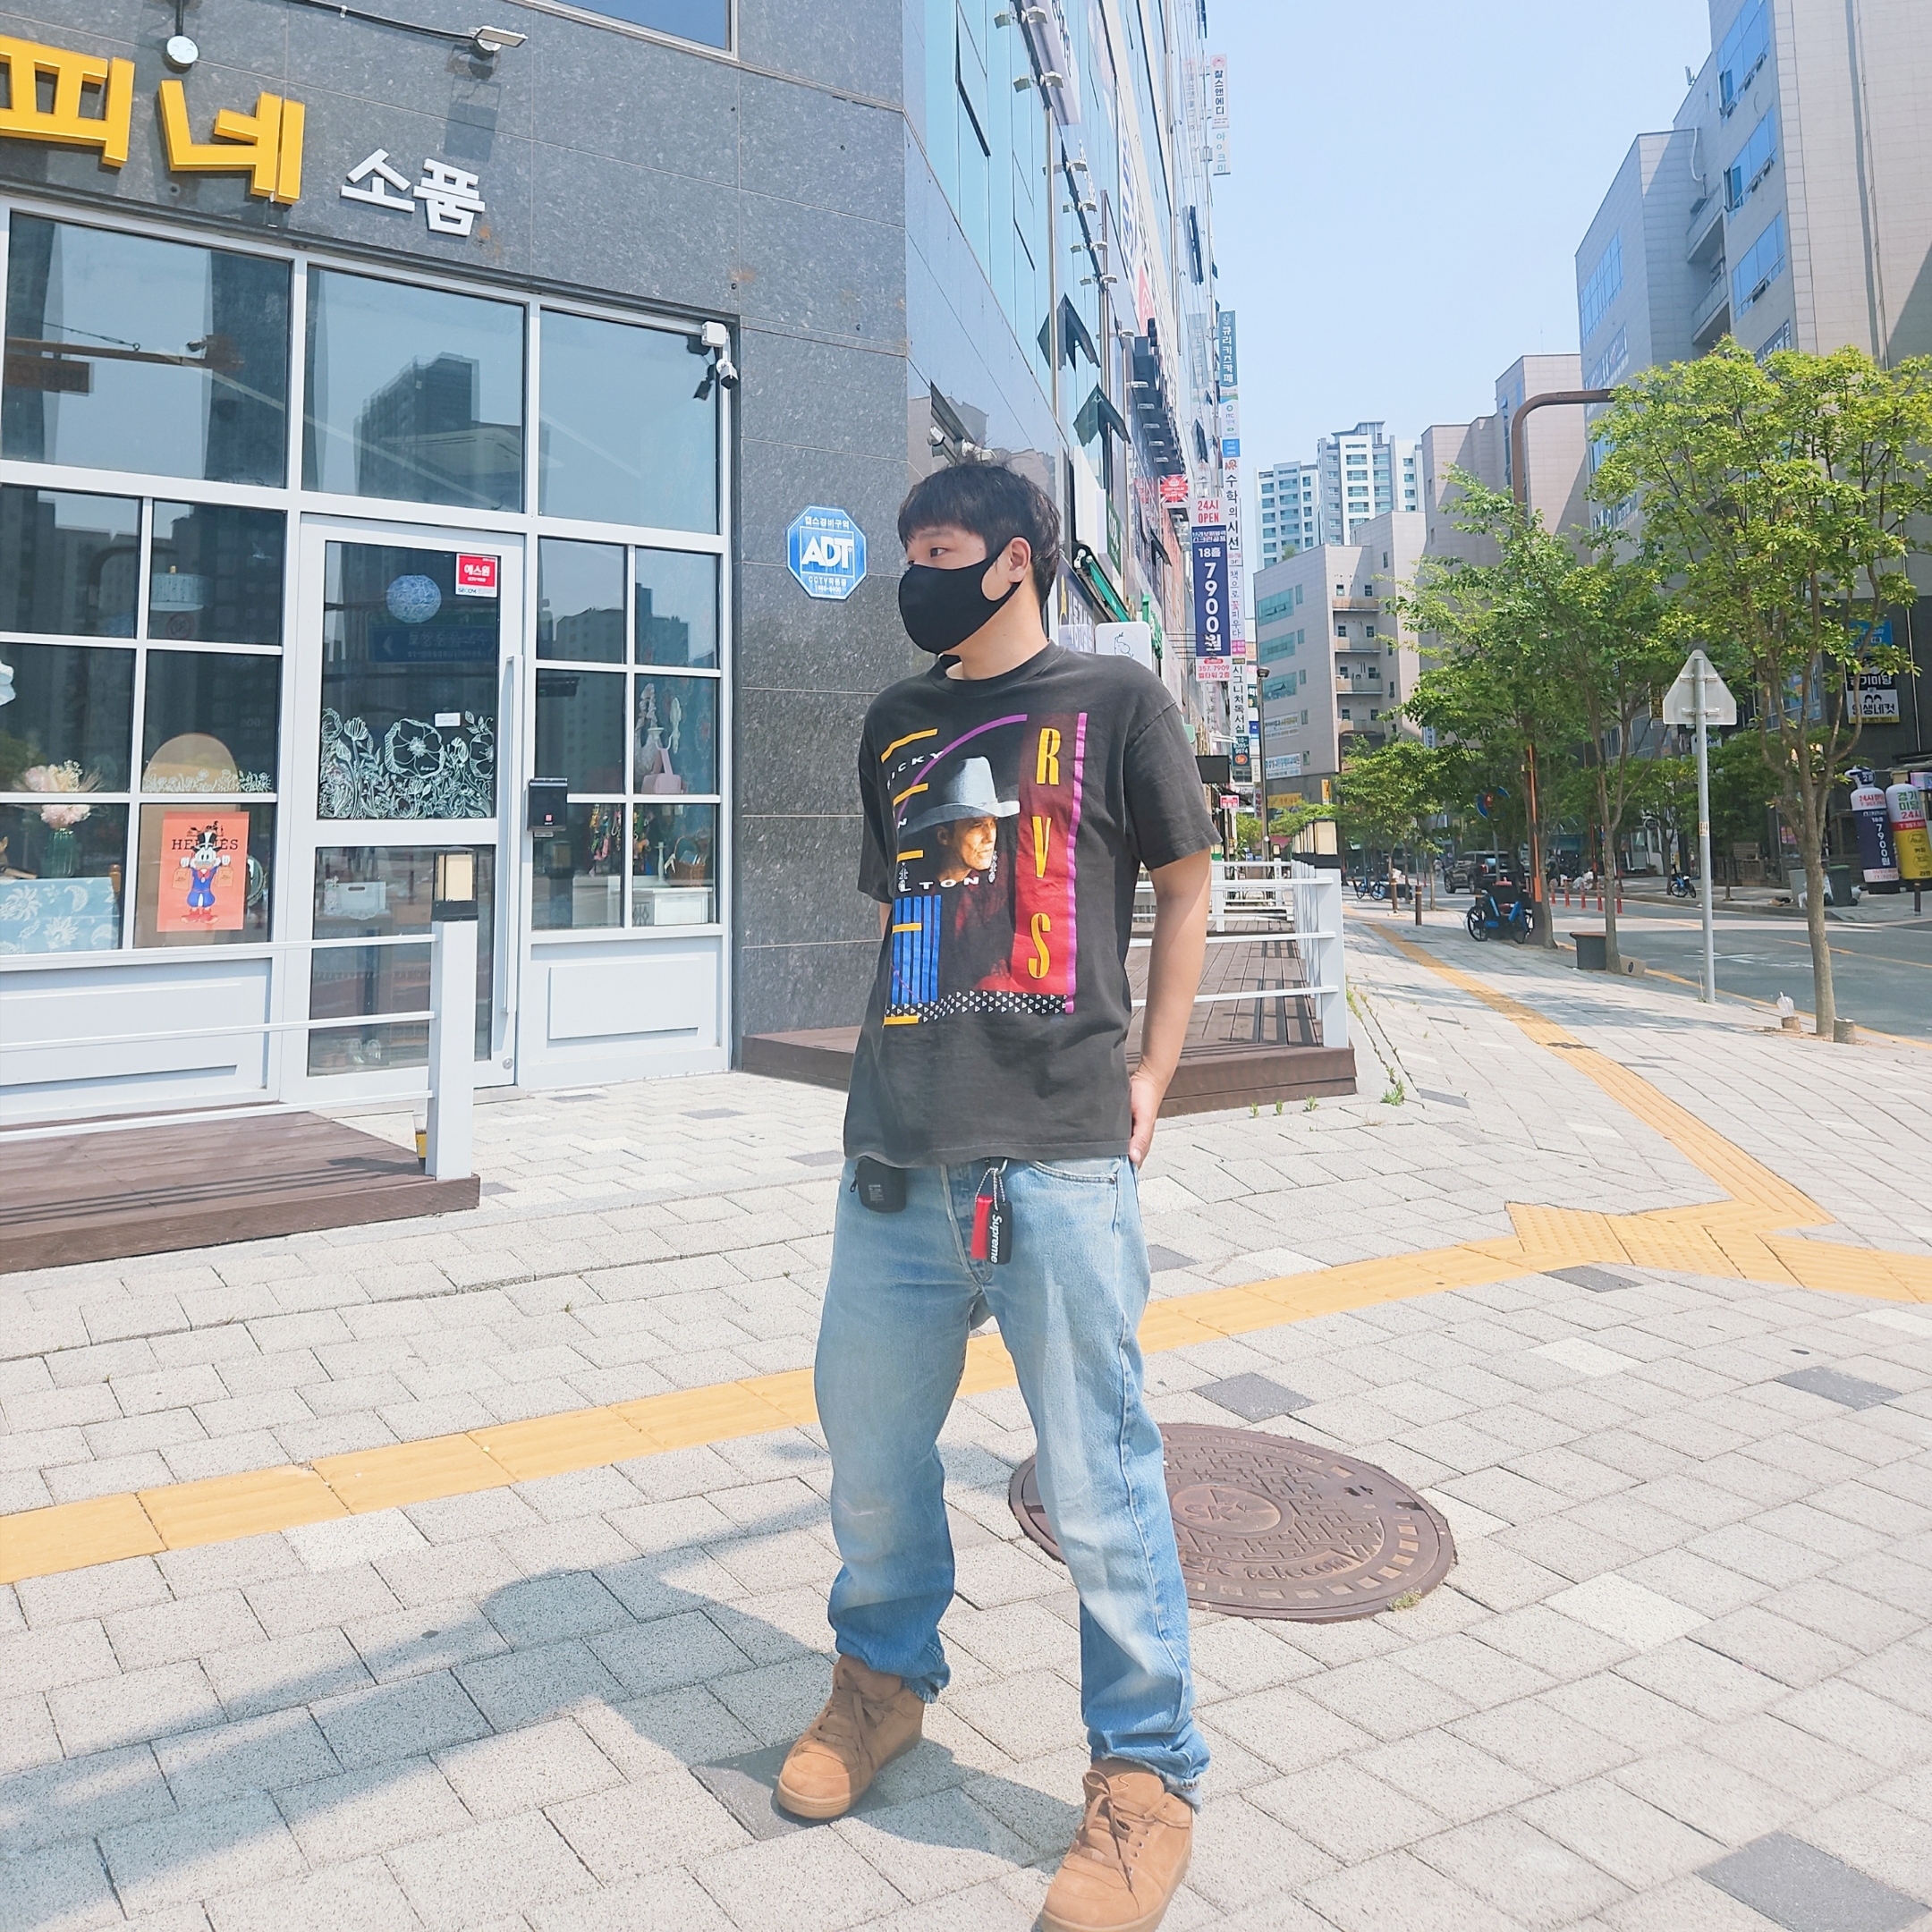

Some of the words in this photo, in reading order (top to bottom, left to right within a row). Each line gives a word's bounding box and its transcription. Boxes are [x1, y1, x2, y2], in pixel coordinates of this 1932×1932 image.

[341, 148, 486, 236] 소품
[1222, 326, 1233, 383] 큐리키즈카페
[1198, 500, 1219, 511] 24시
[1198, 513, 1219, 523] OPEN
[1225, 474, 1239, 551] 수학의시선
[801, 536, 852, 569] ADT
[464, 564, 490, 577] 에스원
[1897, 792, 1918, 801] 경기
[1899, 802, 1919, 810] 미당
[1901, 811, 1922, 819] 24시
[991, 1214, 1003, 1264] Supreme
